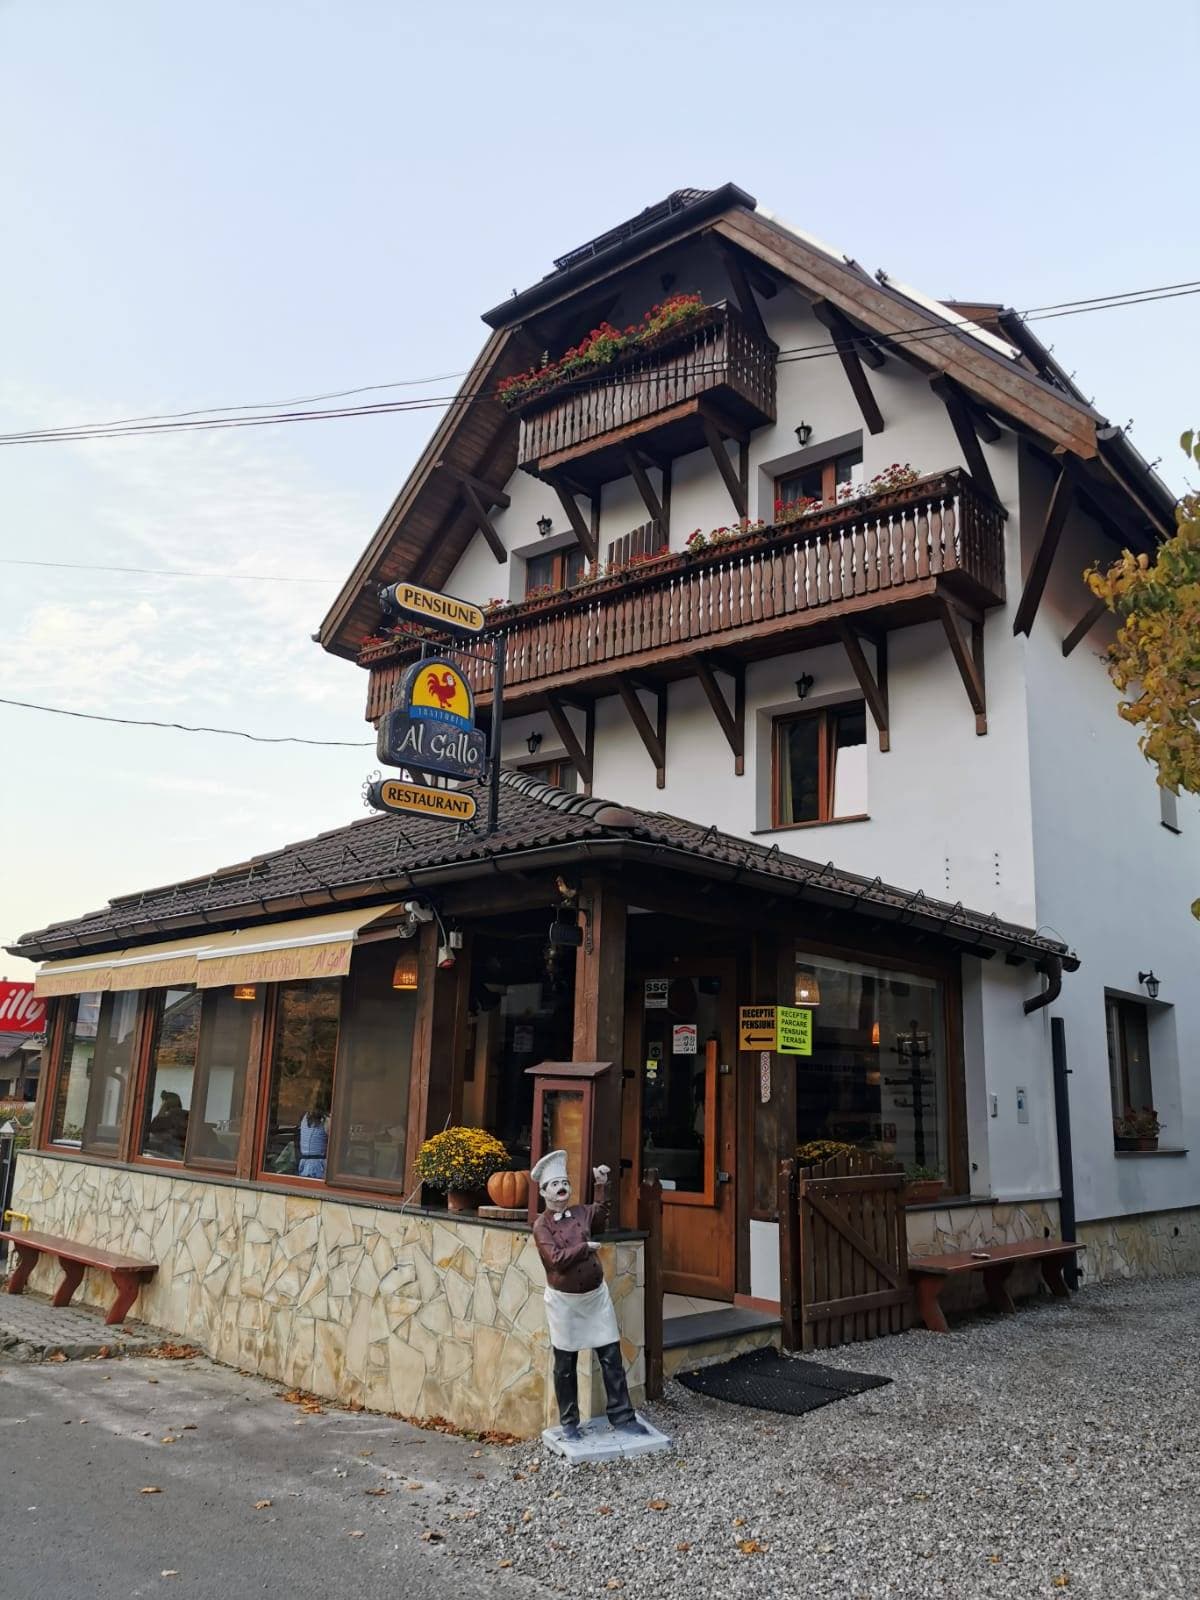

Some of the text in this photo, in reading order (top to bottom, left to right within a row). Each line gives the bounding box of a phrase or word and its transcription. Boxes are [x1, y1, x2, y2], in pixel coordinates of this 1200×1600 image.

[404, 588, 477, 625] PENSIUNE
[396, 723, 478, 764] Al Gallo
[387, 787, 470, 814] RESTAURANT
[646, 982, 668, 992] SSG
[0, 988, 45, 1028] illy
[742, 1008, 775, 1018] RECEPTIE
[781, 1010, 808, 1020] RECEPTIE
[741, 1020, 775, 1030] PENSIUNE
[781, 1018, 808, 1028] PARCARE
[780, 1027, 808, 1037] PENSIUNE
[783, 1036, 807, 1044] TERASA
